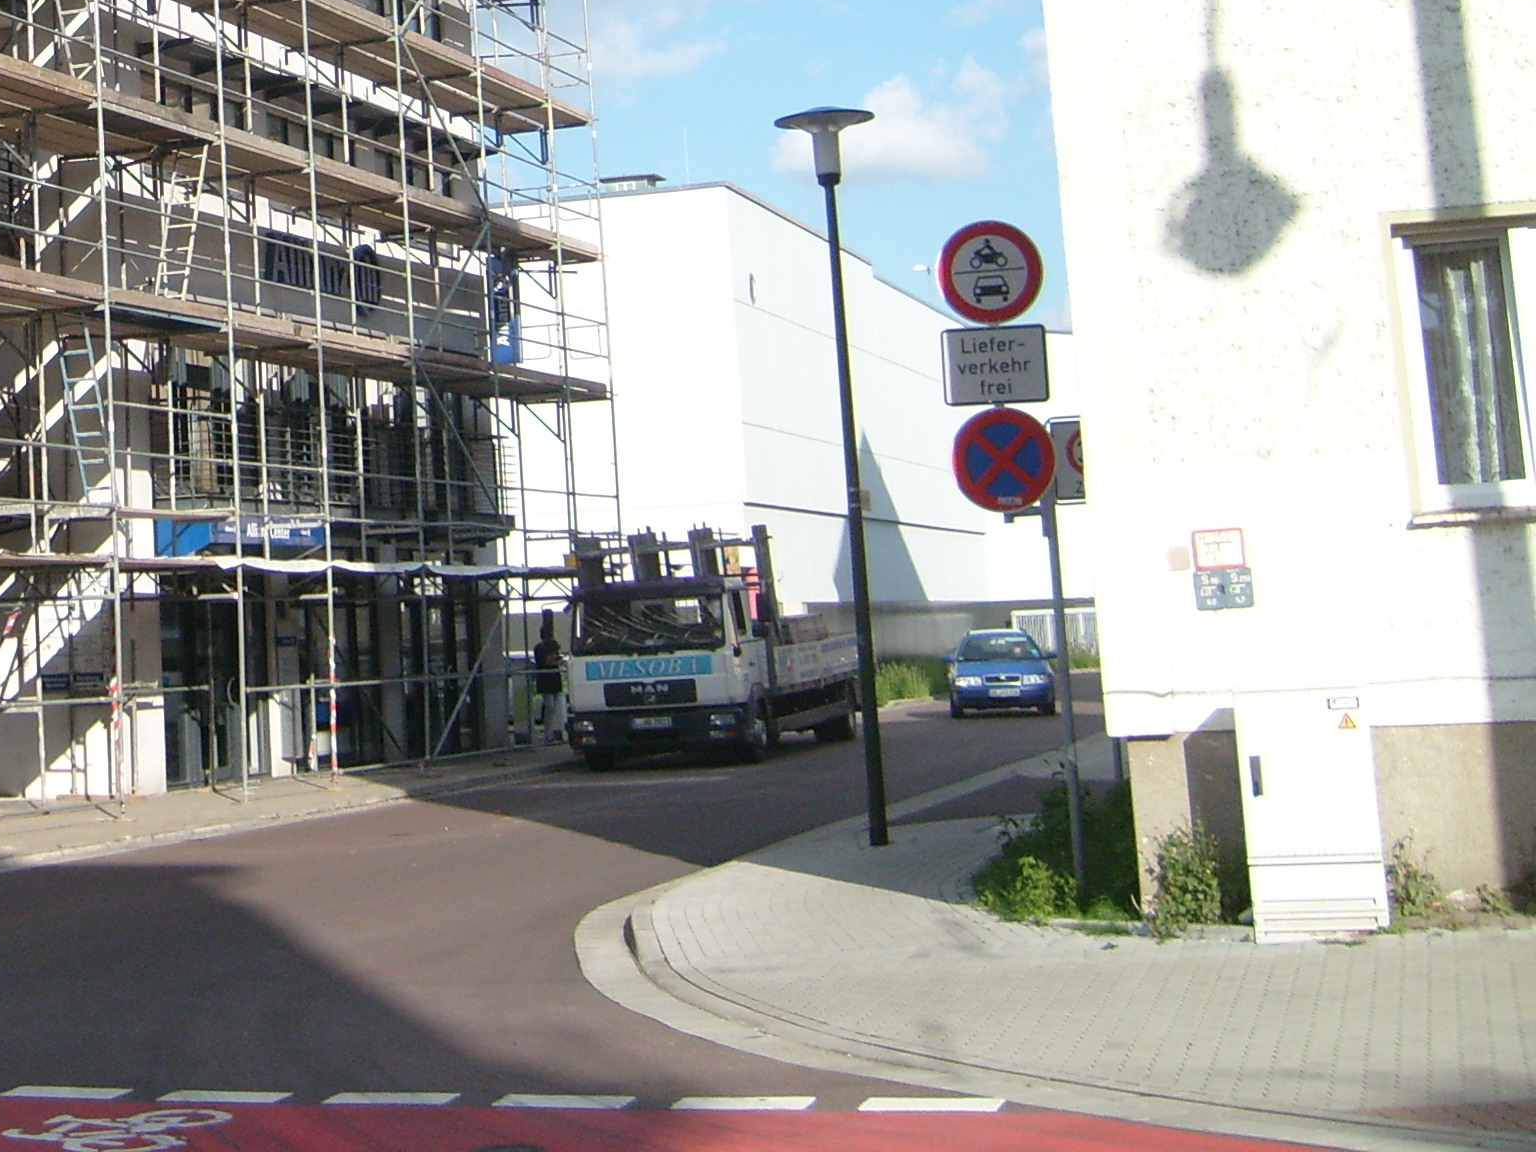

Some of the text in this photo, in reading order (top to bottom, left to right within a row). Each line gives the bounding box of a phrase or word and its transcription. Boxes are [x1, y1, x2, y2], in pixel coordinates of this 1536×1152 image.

[960, 336, 1025, 355] Liefer-
[956, 358, 1032, 375] verkehr
[980, 378, 1013, 396] frei
[630, 683, 669, 695] MAN
